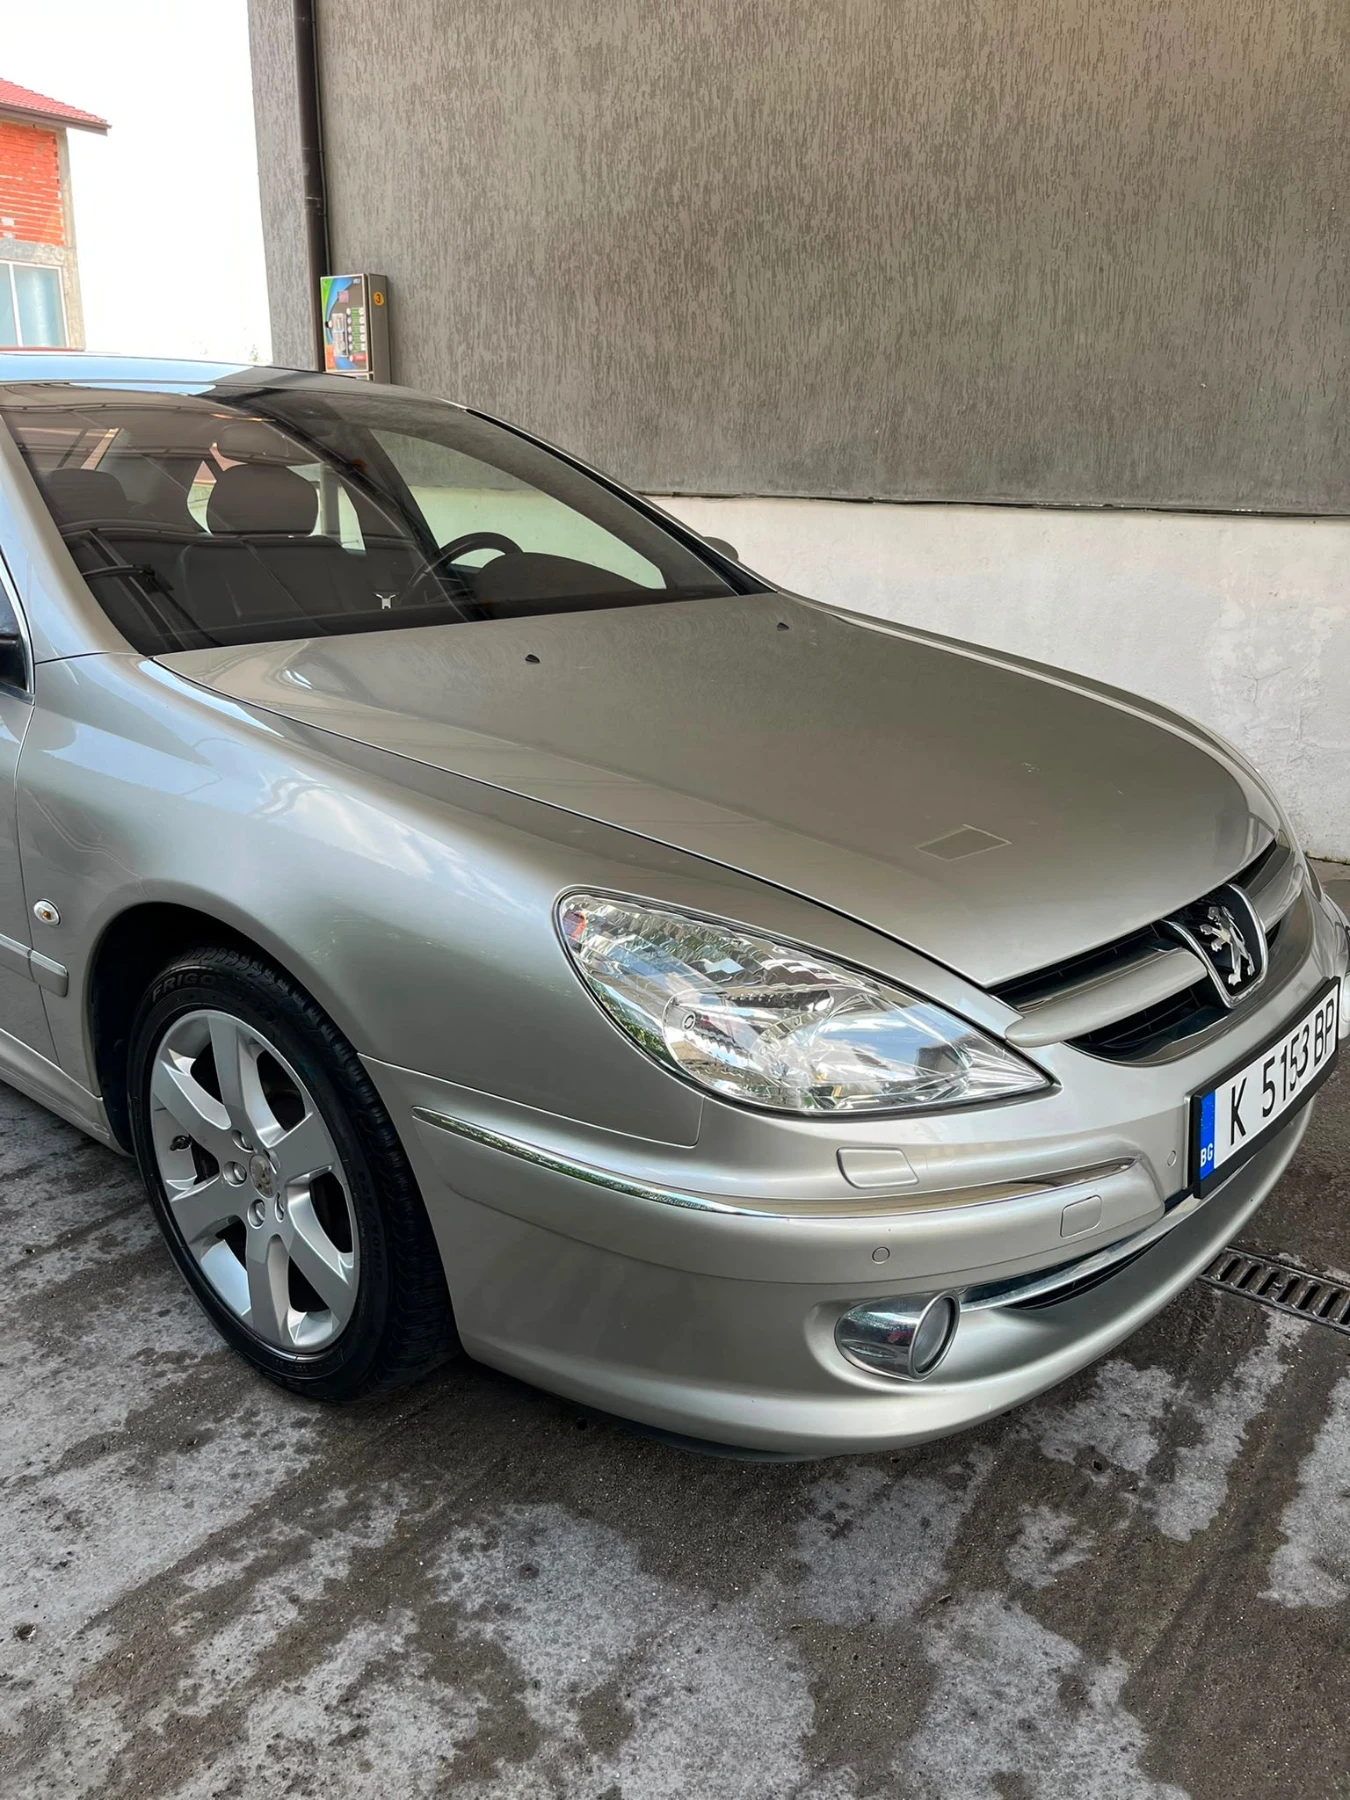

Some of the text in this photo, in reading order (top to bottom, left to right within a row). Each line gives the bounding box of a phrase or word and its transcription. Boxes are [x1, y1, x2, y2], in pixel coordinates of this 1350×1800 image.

[151, 972, 218, 1003] FRIGO
[1230, 998, 1335, 1147] K 5153 BP
[1200, 1143, 1214, 1168] BG
